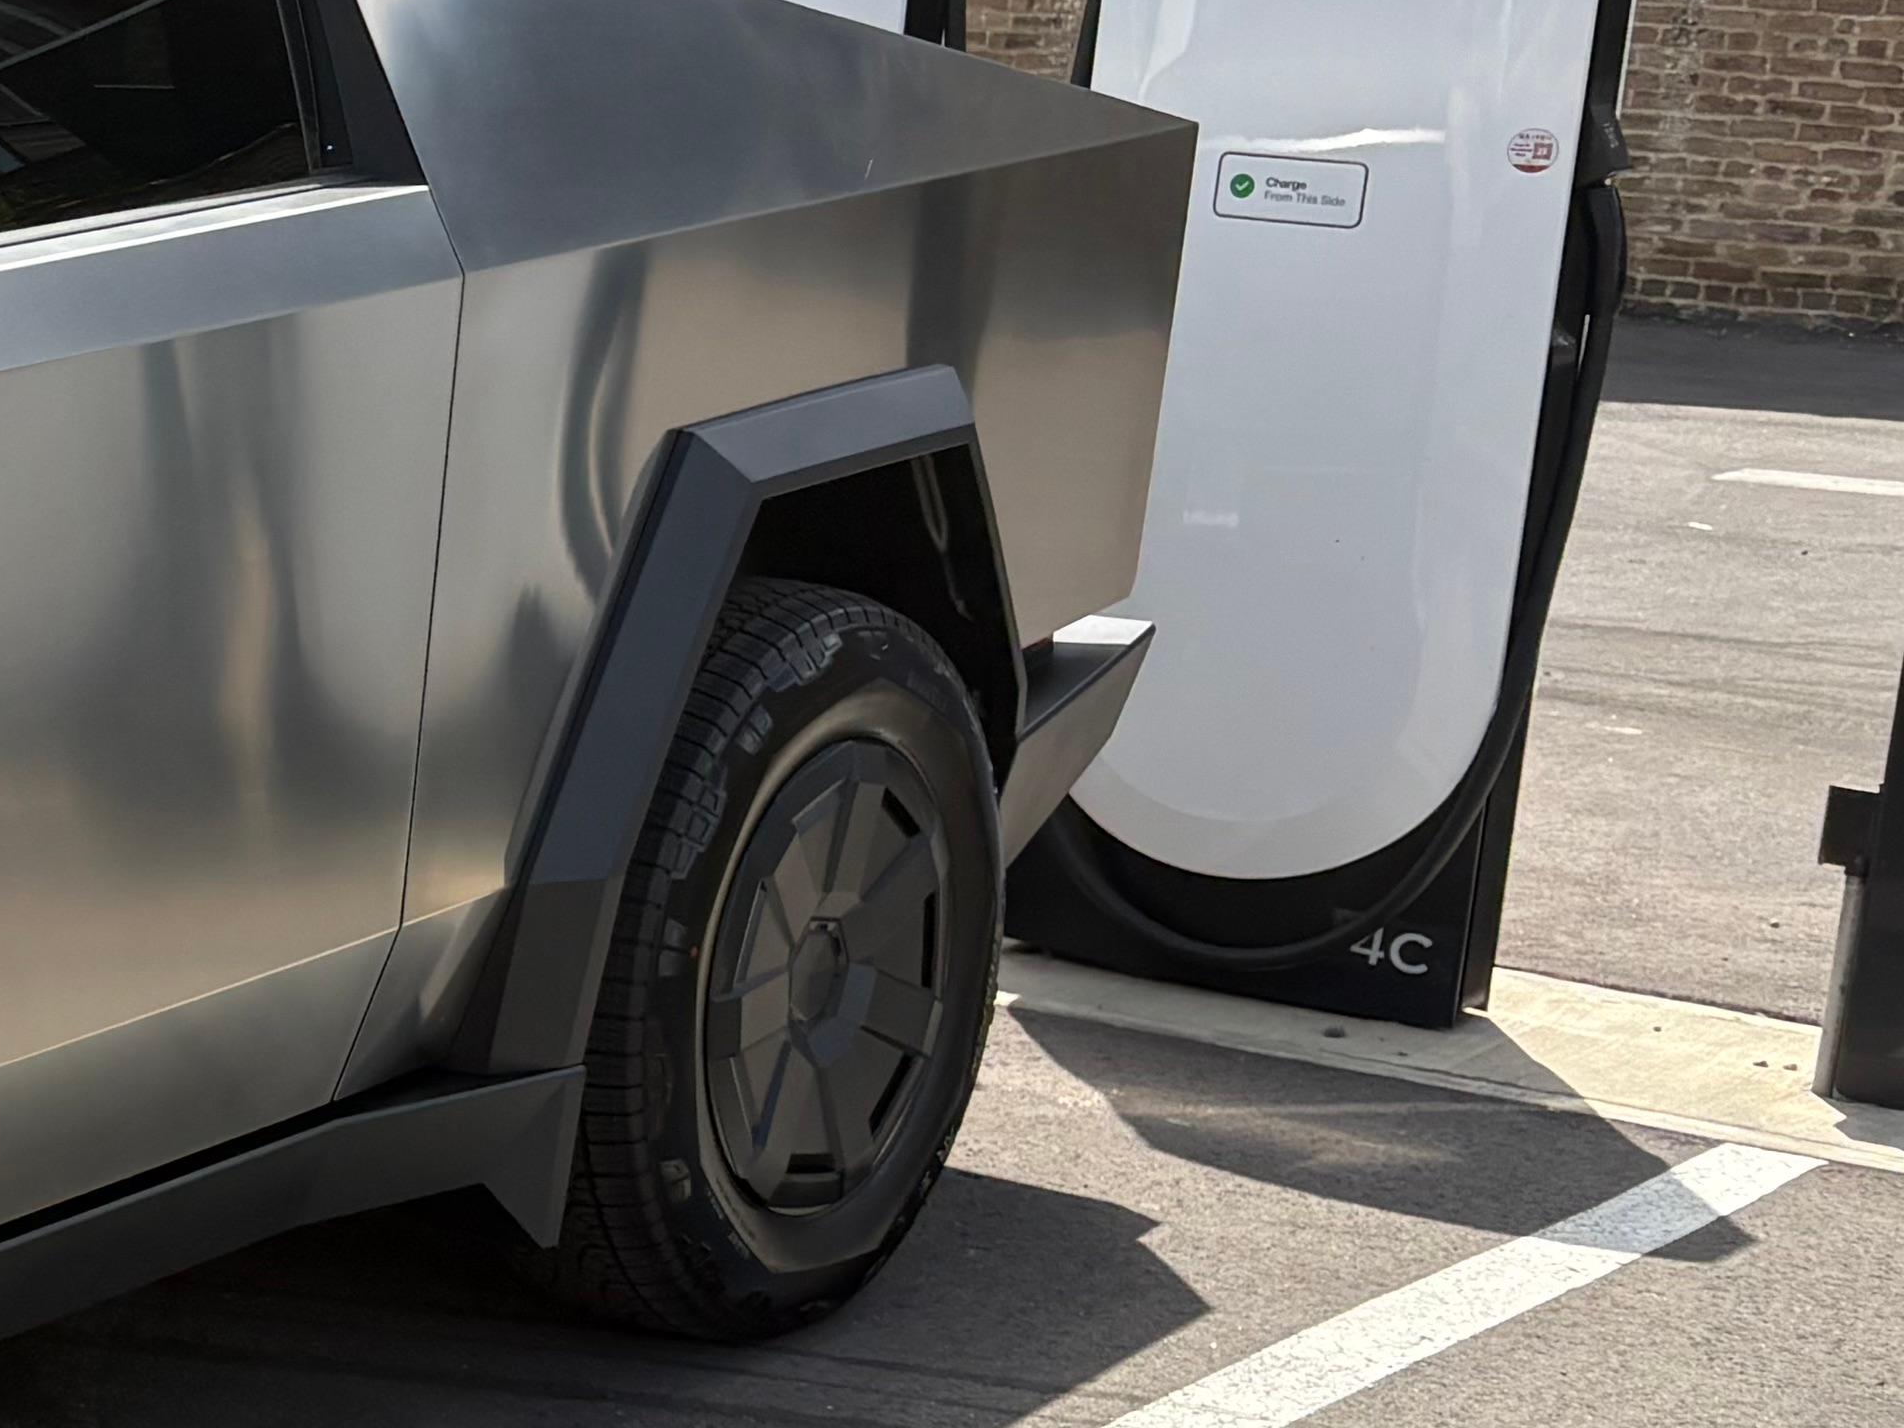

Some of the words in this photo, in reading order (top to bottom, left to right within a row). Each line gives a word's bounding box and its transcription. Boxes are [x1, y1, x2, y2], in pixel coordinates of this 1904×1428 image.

[1265, 176, 1308, 191] Charge
[1264, 190, 1293, 203] From
[1296, 192, 1318, 205] This
[1321, 195, 1346, 207] Side
[1349, 926, 1434, 975] 4C
